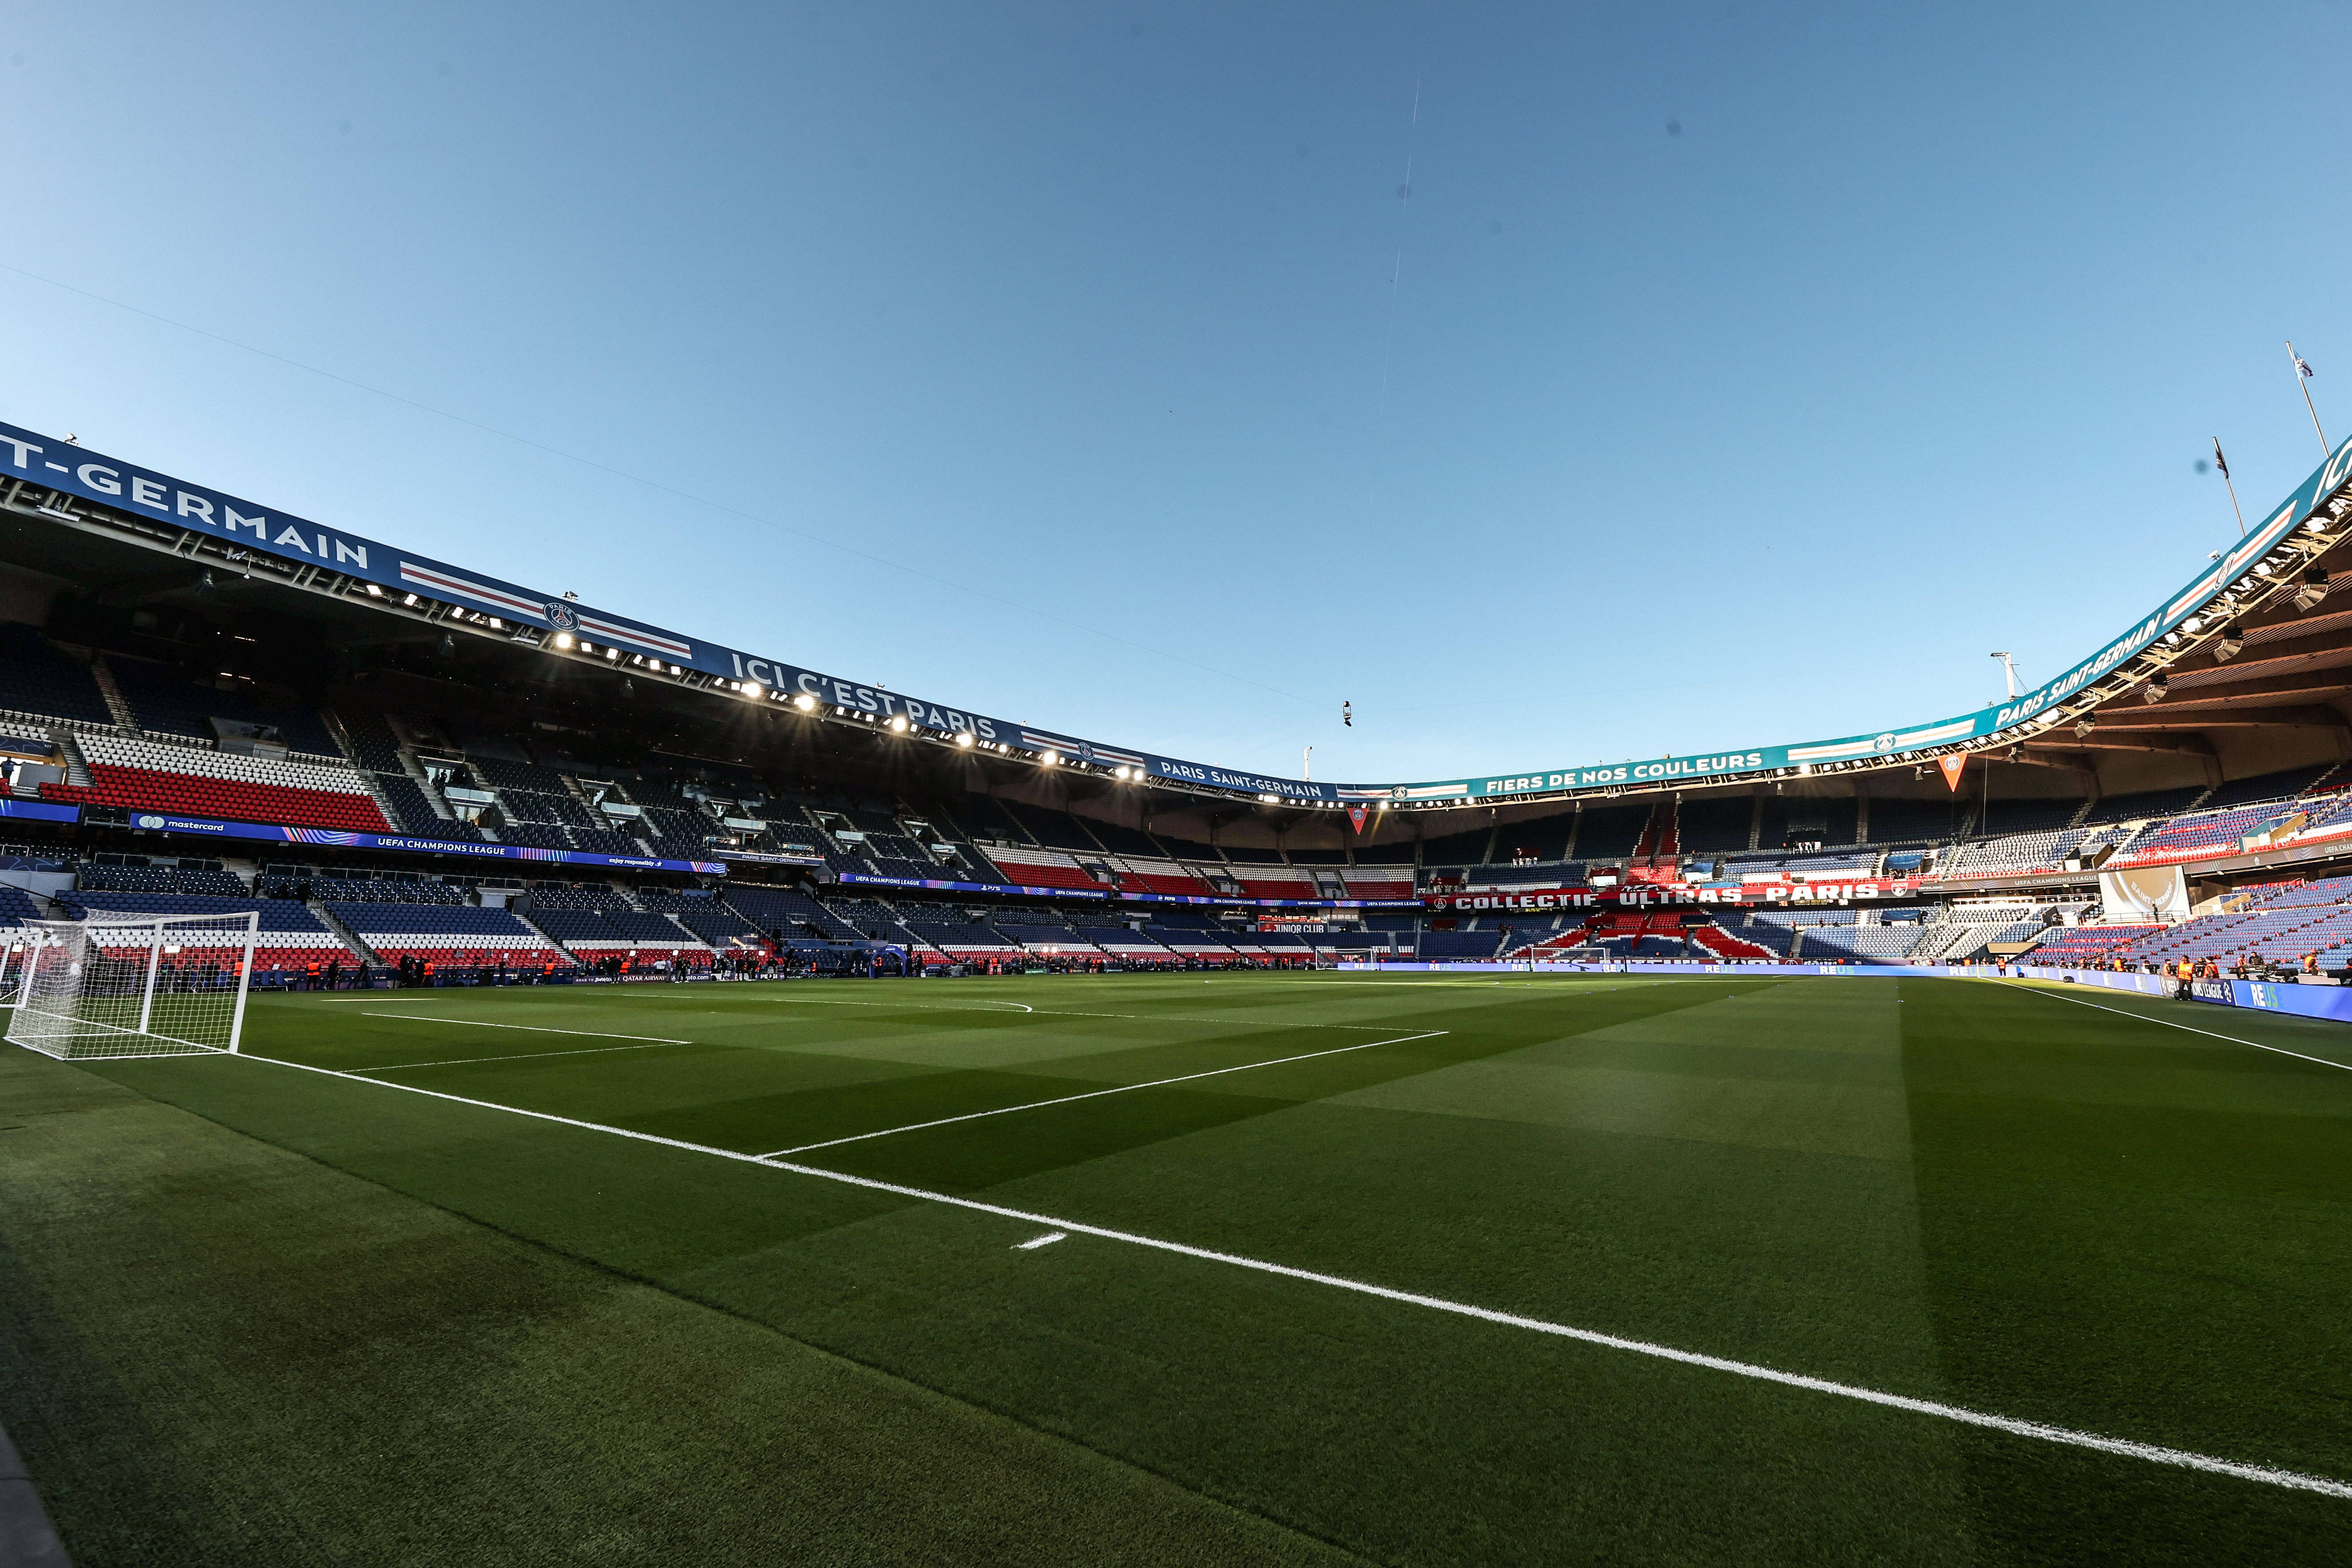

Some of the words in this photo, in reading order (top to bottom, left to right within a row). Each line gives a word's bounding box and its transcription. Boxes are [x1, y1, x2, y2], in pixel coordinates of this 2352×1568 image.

[549, 604, 572, 614] PARIS
[1996, 689, 2047, 727] PARIS
[2048, 612, 2162, 701] SAINT-GERMAIN
[732, 653, 784, 689] ICI
[798, 673, 895, 715] C'EST
[905, 700, 996, 739] PARIS
[1161, 762, 1205, 779] PARIS
[1211, 771, 1322, 796] SAINT-GERMAIN
[1487, 776, 1543, 793] FIERS
[1549, 772, 1576, 787] DE
[1583, 765, 1627, 784] NOS
[1634, 753, 1763, 778] COULEURS
[168, 821, 224, 831] mastercard
[378, 838, 404, 847] UEFA
[407, 840, 467, 852] CHAMPIONS
[469, 845, 505, 855] LEAGUE
[2032, 876, 2071, 884] CHAMPIONS
[1456, 893, 1599, 909] COLLECTIF
[1620, 888, 1743, 905] ULTRAS
[1766, 883, 1879, 901] PARIS
[2131, 881, 2152, 904] SAINT
[2155, 881, 2173, 906] GERMAIN
[1274, 924, 1302, 933] JUNIOR
[1303, 924, 1324, 933] CLUB
[1705, 965, 1736, 973] REUS
[1820, 966, 1855, 974] REUS
[1949, 967, 1988, 976] REUS
[2166, 980, 2176, 993] UEFA
[2202, 983, 2224, 1000] LEAGUE
[2250, 984, 2278, 1008] REUS
